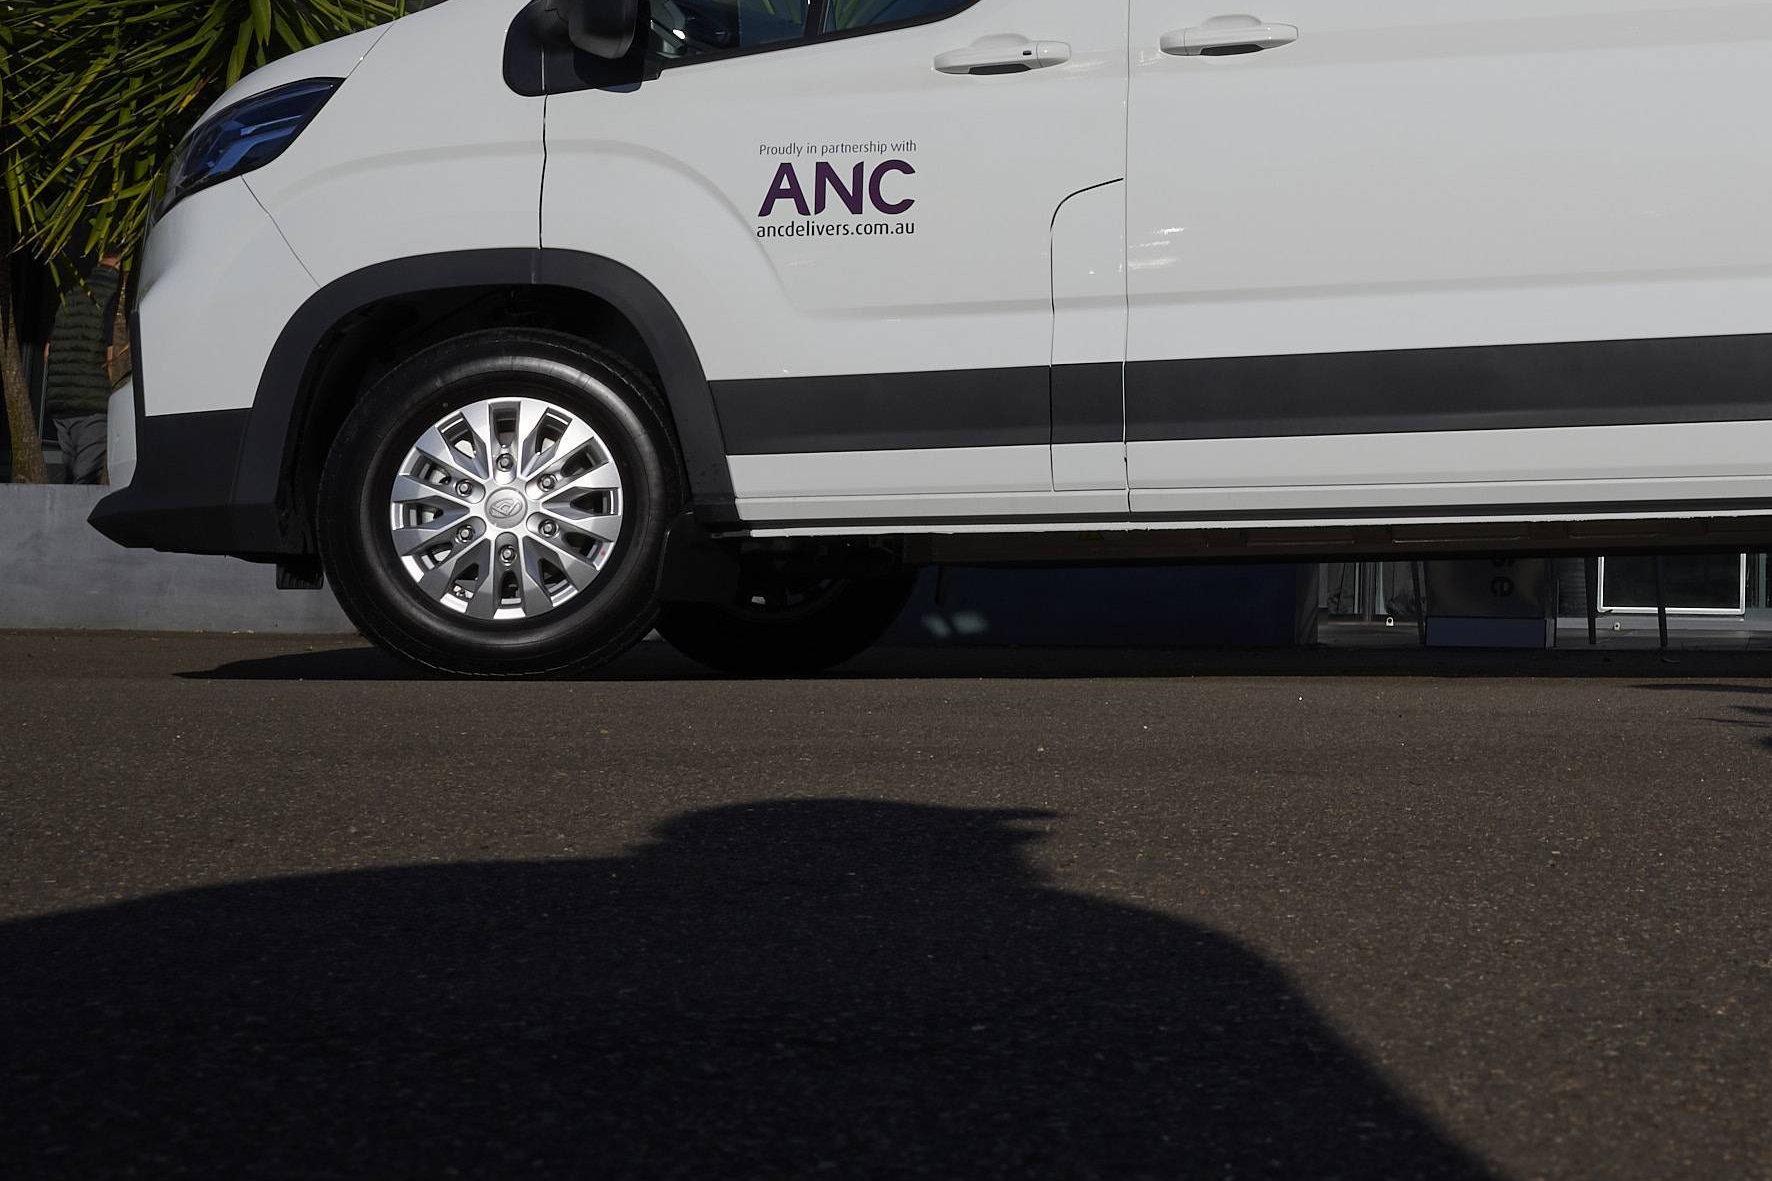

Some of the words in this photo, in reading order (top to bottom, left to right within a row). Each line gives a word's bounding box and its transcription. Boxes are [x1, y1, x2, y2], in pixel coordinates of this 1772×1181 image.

[759, 142, 803, 157] Proudly
[806, 142, 817, 155] in
[821, 140, 888, 157] partnership
[890, 139, 917, 152] with
[757, 159, 916, 217] ANC
[756, 220, 916, 238] ancdelivers.com.au
